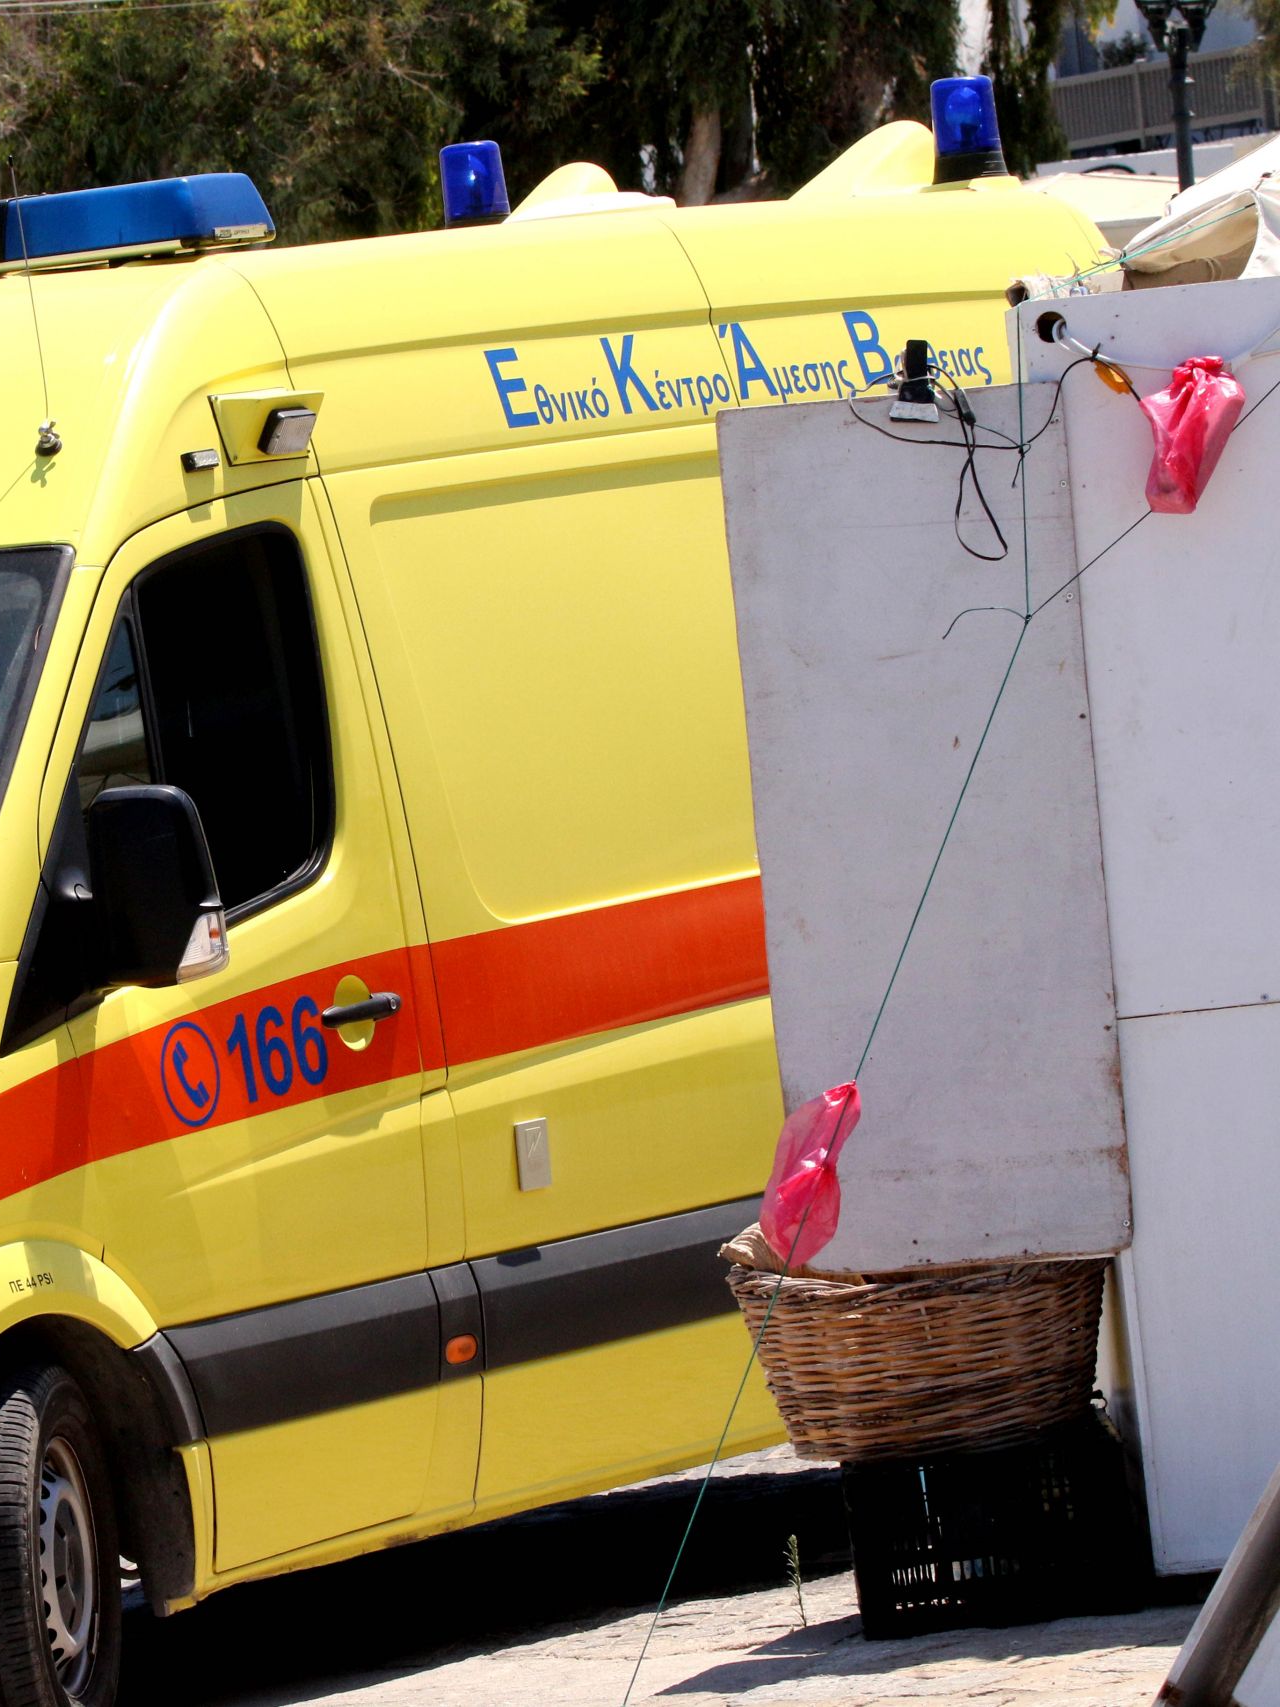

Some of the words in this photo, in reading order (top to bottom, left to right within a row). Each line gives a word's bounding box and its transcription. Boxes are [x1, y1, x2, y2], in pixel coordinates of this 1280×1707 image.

[483, 347, 610, 428] Εθνικό
[599, 334, 730, 415] Κέντρο
[718, 322, 856, 404] Άμεσης
[226, 995, 328, 1104] 166
[26, 1276, 37, 1288] 44
[37, 1272, 54, 1287] PSI
